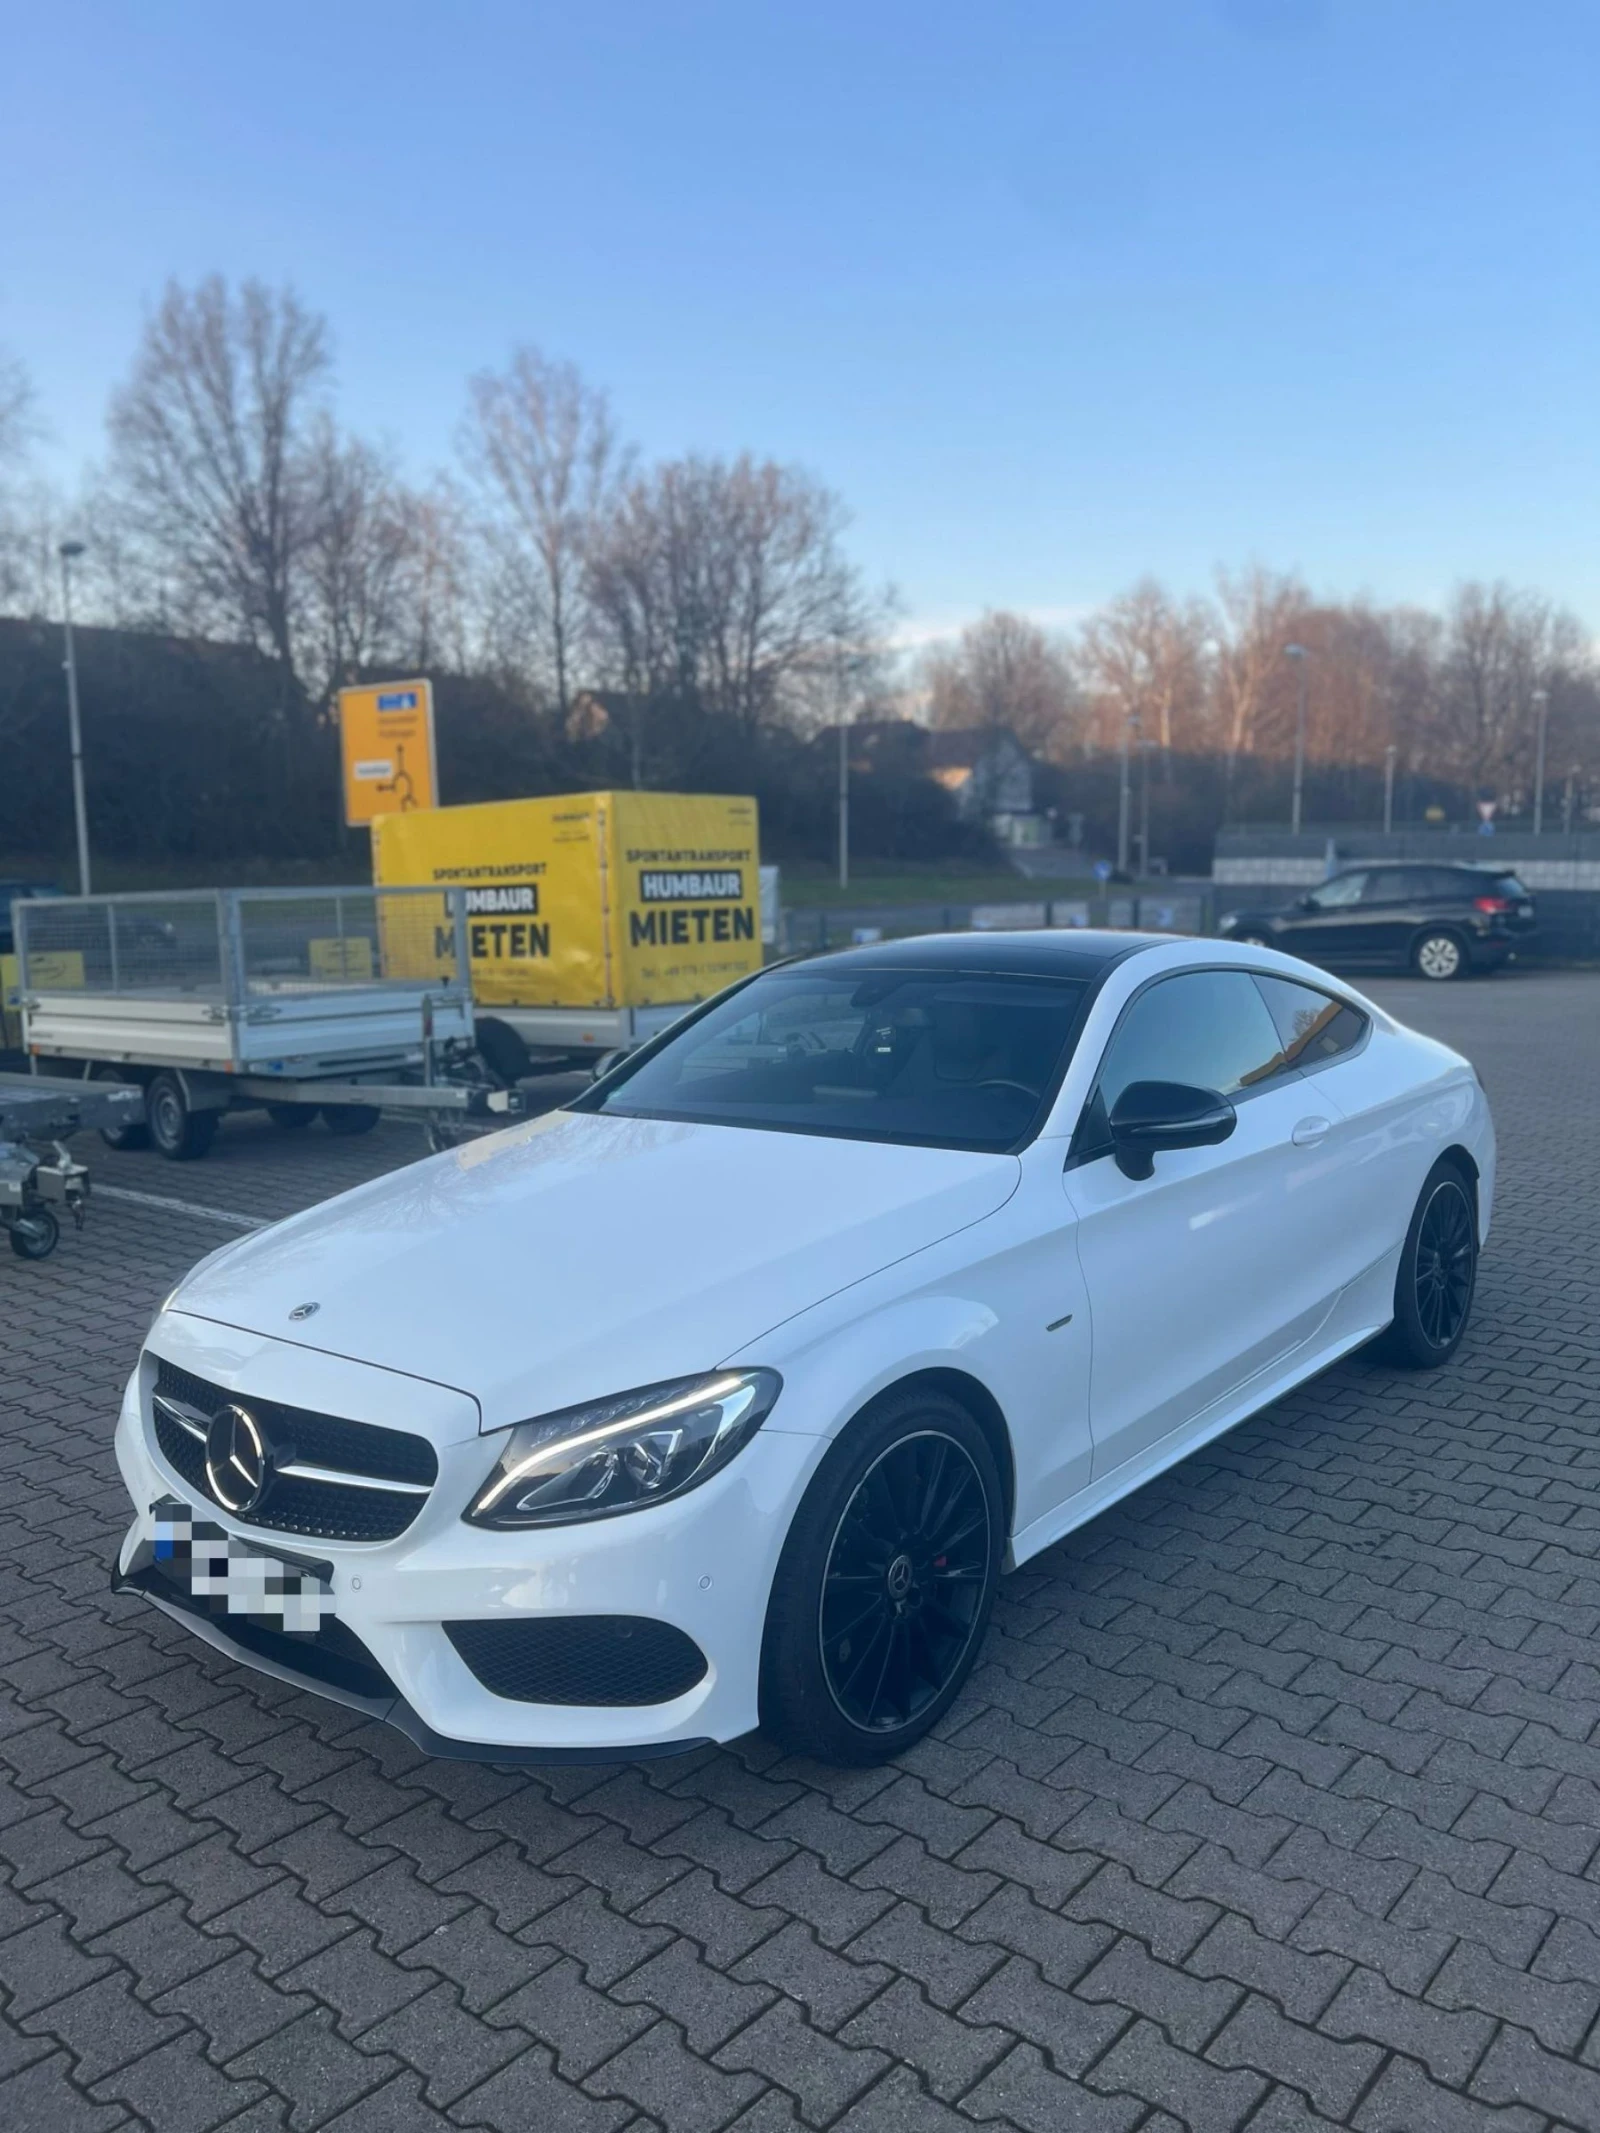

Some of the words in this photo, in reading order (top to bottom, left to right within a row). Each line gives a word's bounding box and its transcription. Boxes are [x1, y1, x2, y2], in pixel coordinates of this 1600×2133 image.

[642, 872, 741, 898] HUMBAUR
[434, 922, 550, 959] METEN
[629, 906, 755, 947] MIETEN
